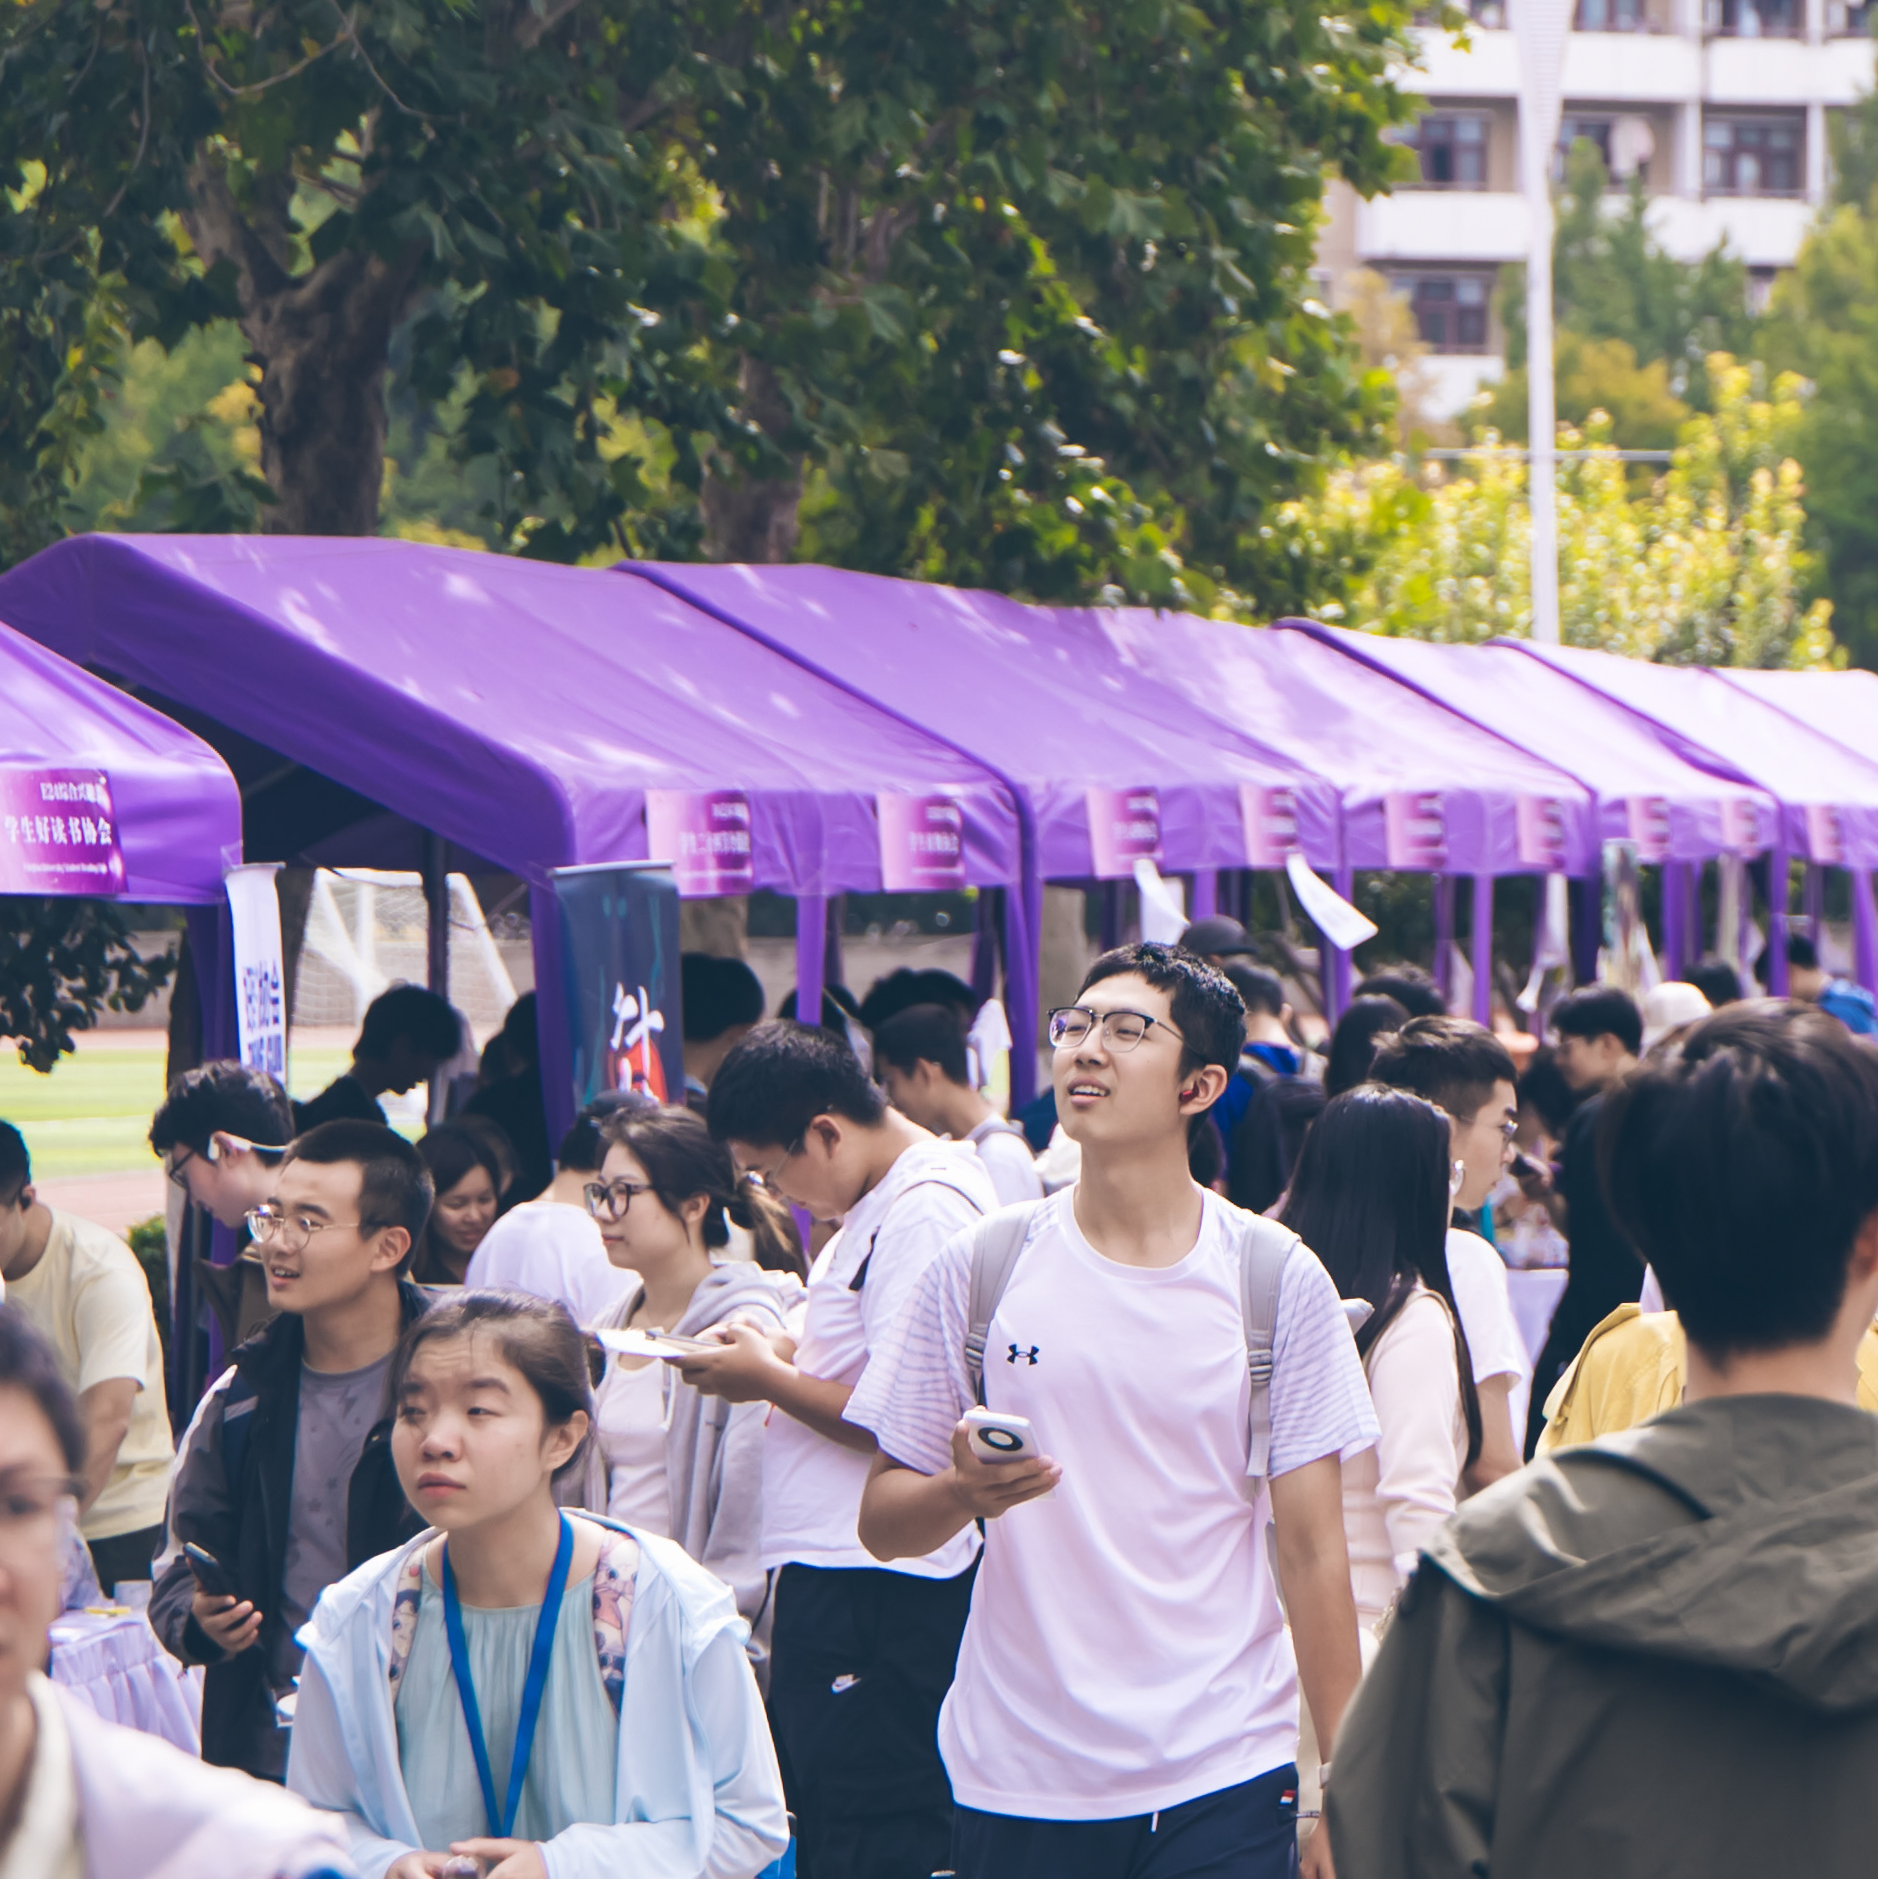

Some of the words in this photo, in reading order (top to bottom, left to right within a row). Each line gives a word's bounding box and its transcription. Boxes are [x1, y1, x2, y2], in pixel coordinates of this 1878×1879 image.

[4, 814, 112, 845] 学生好读书协会
